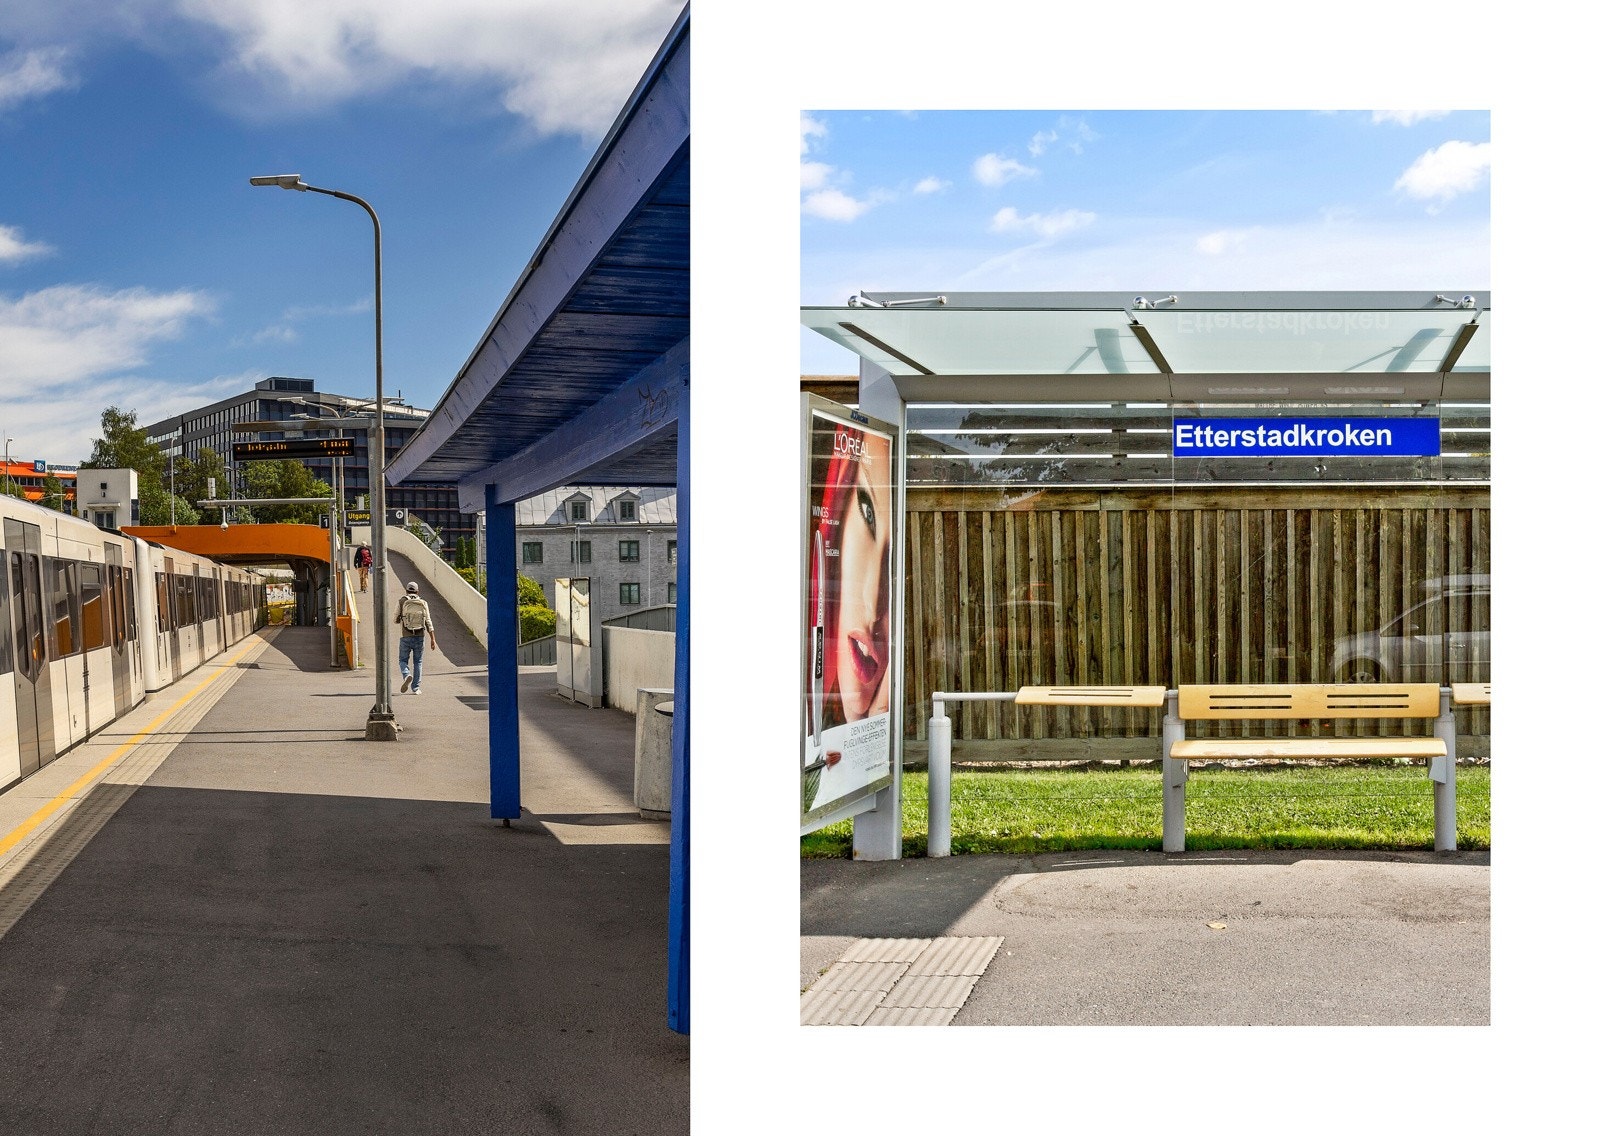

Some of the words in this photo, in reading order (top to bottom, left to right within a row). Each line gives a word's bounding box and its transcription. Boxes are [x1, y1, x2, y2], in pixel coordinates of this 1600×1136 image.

[1176, 424, 1392, 448] Etterstadkroken
[834, 433, 871, 458] L'ORÉAL
[811, 505, 829, 518] WINGS
[323, 518, 328, 527] 1
